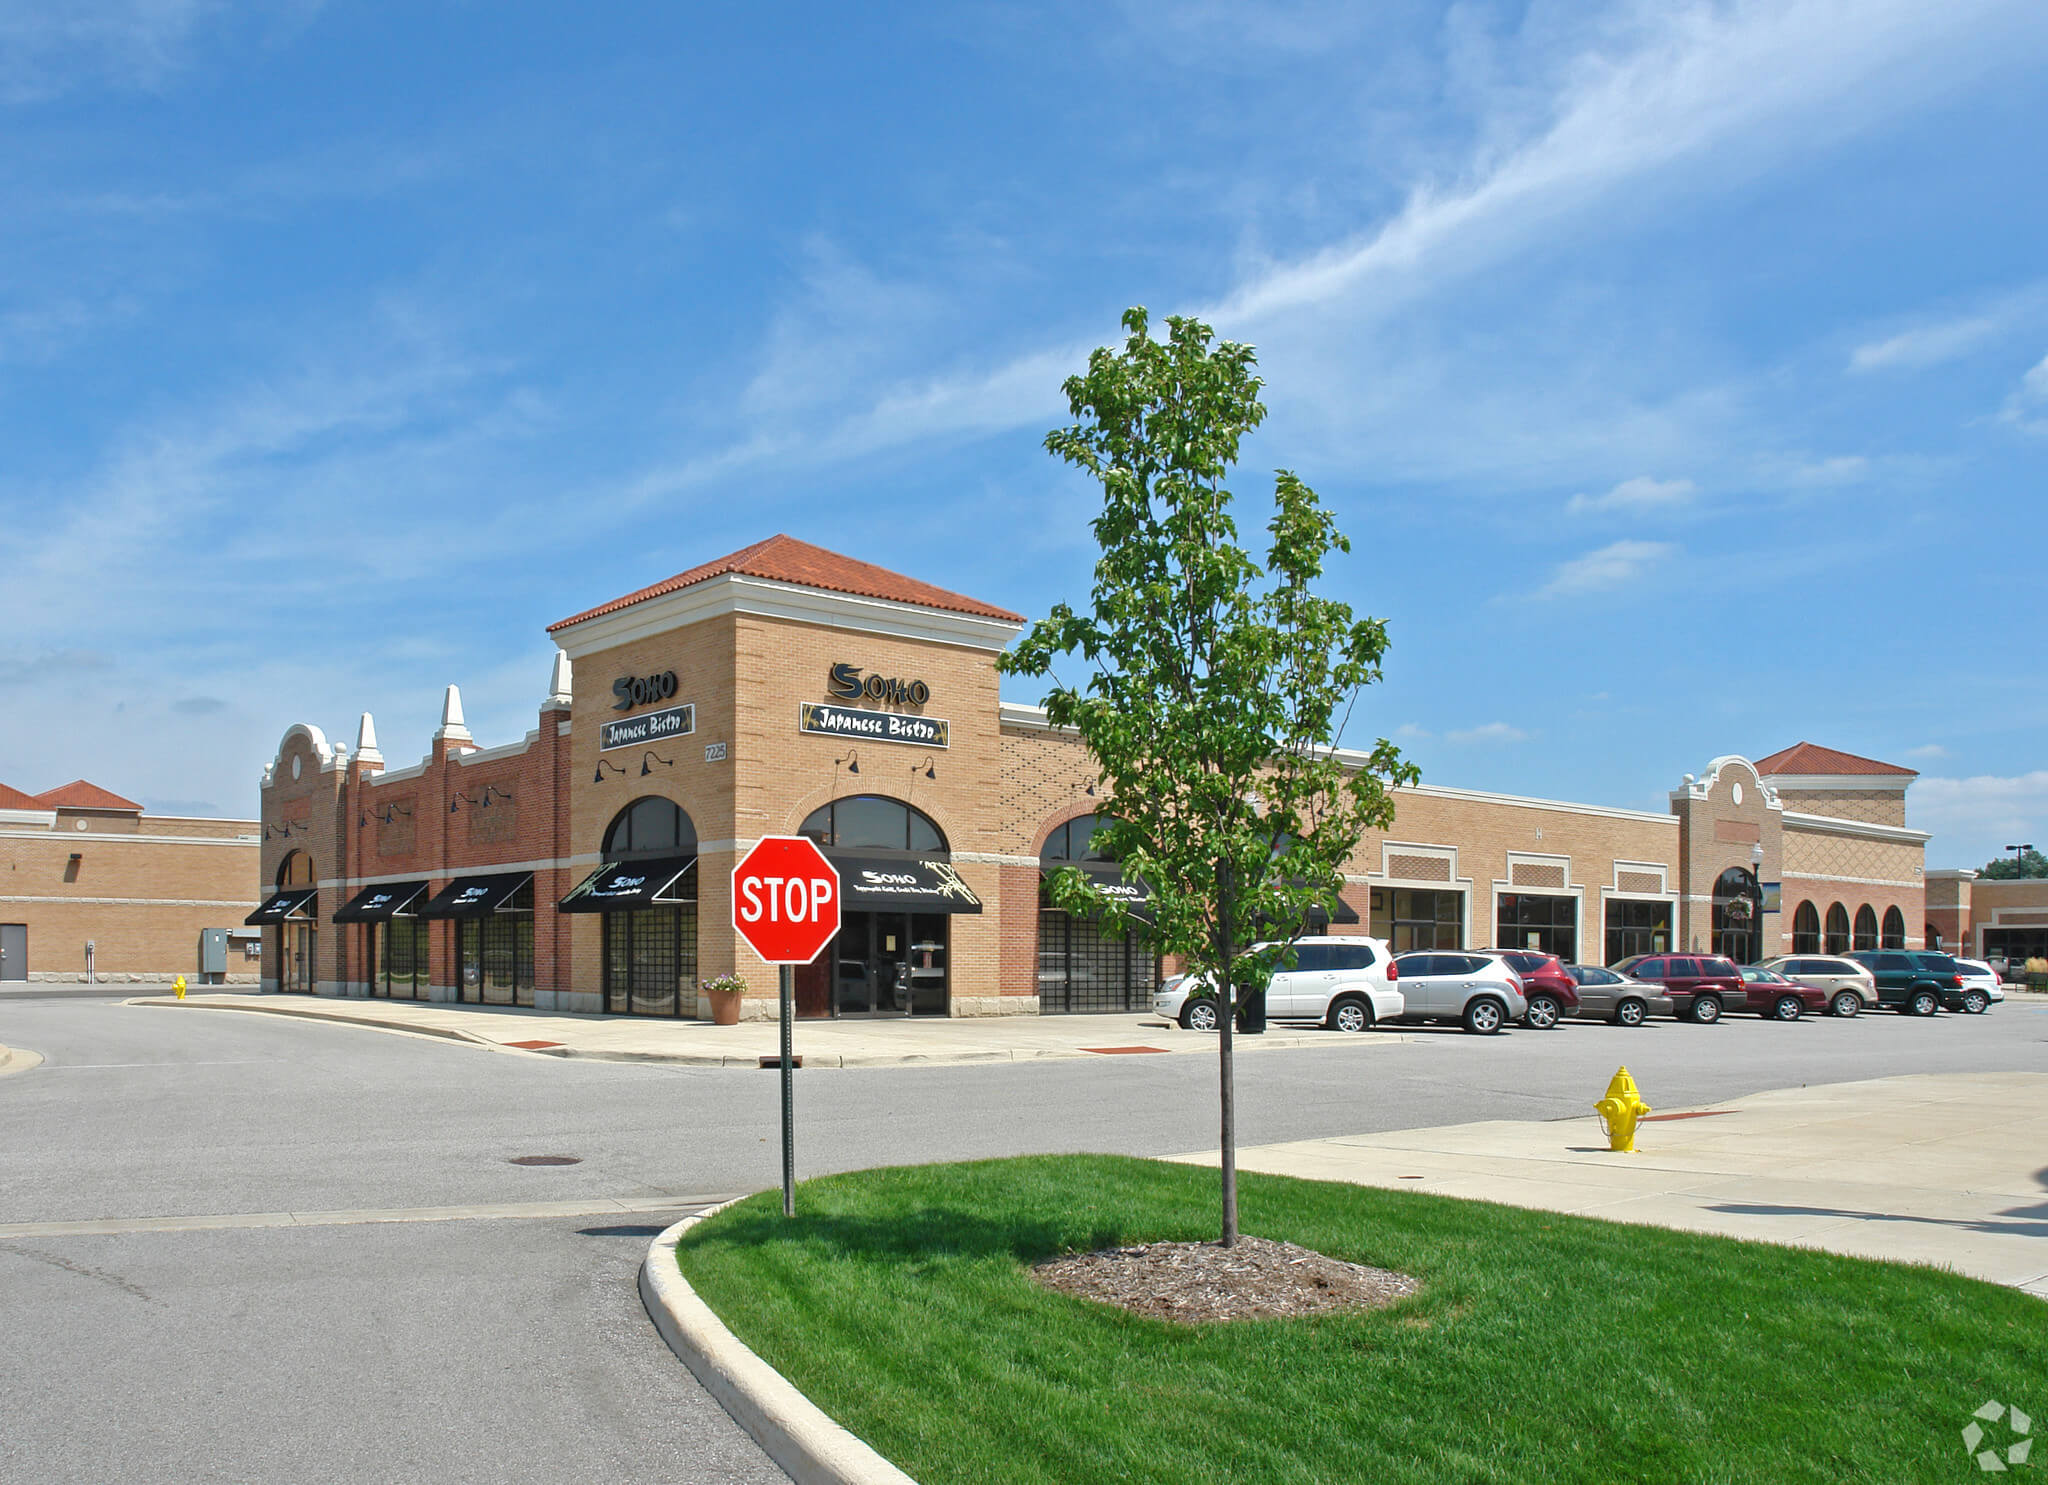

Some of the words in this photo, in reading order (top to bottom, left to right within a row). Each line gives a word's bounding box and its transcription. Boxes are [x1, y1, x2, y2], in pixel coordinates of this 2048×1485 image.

[608, 723, 647, 745] Japanese
[649, 713, 681, 735] Bistro
[819, 708, 883, 733] Japanese
[888, 716, 934, 739] Bistro
[705, 744, 725, 761] 7225
[740, 876, 832, 922] STOP
